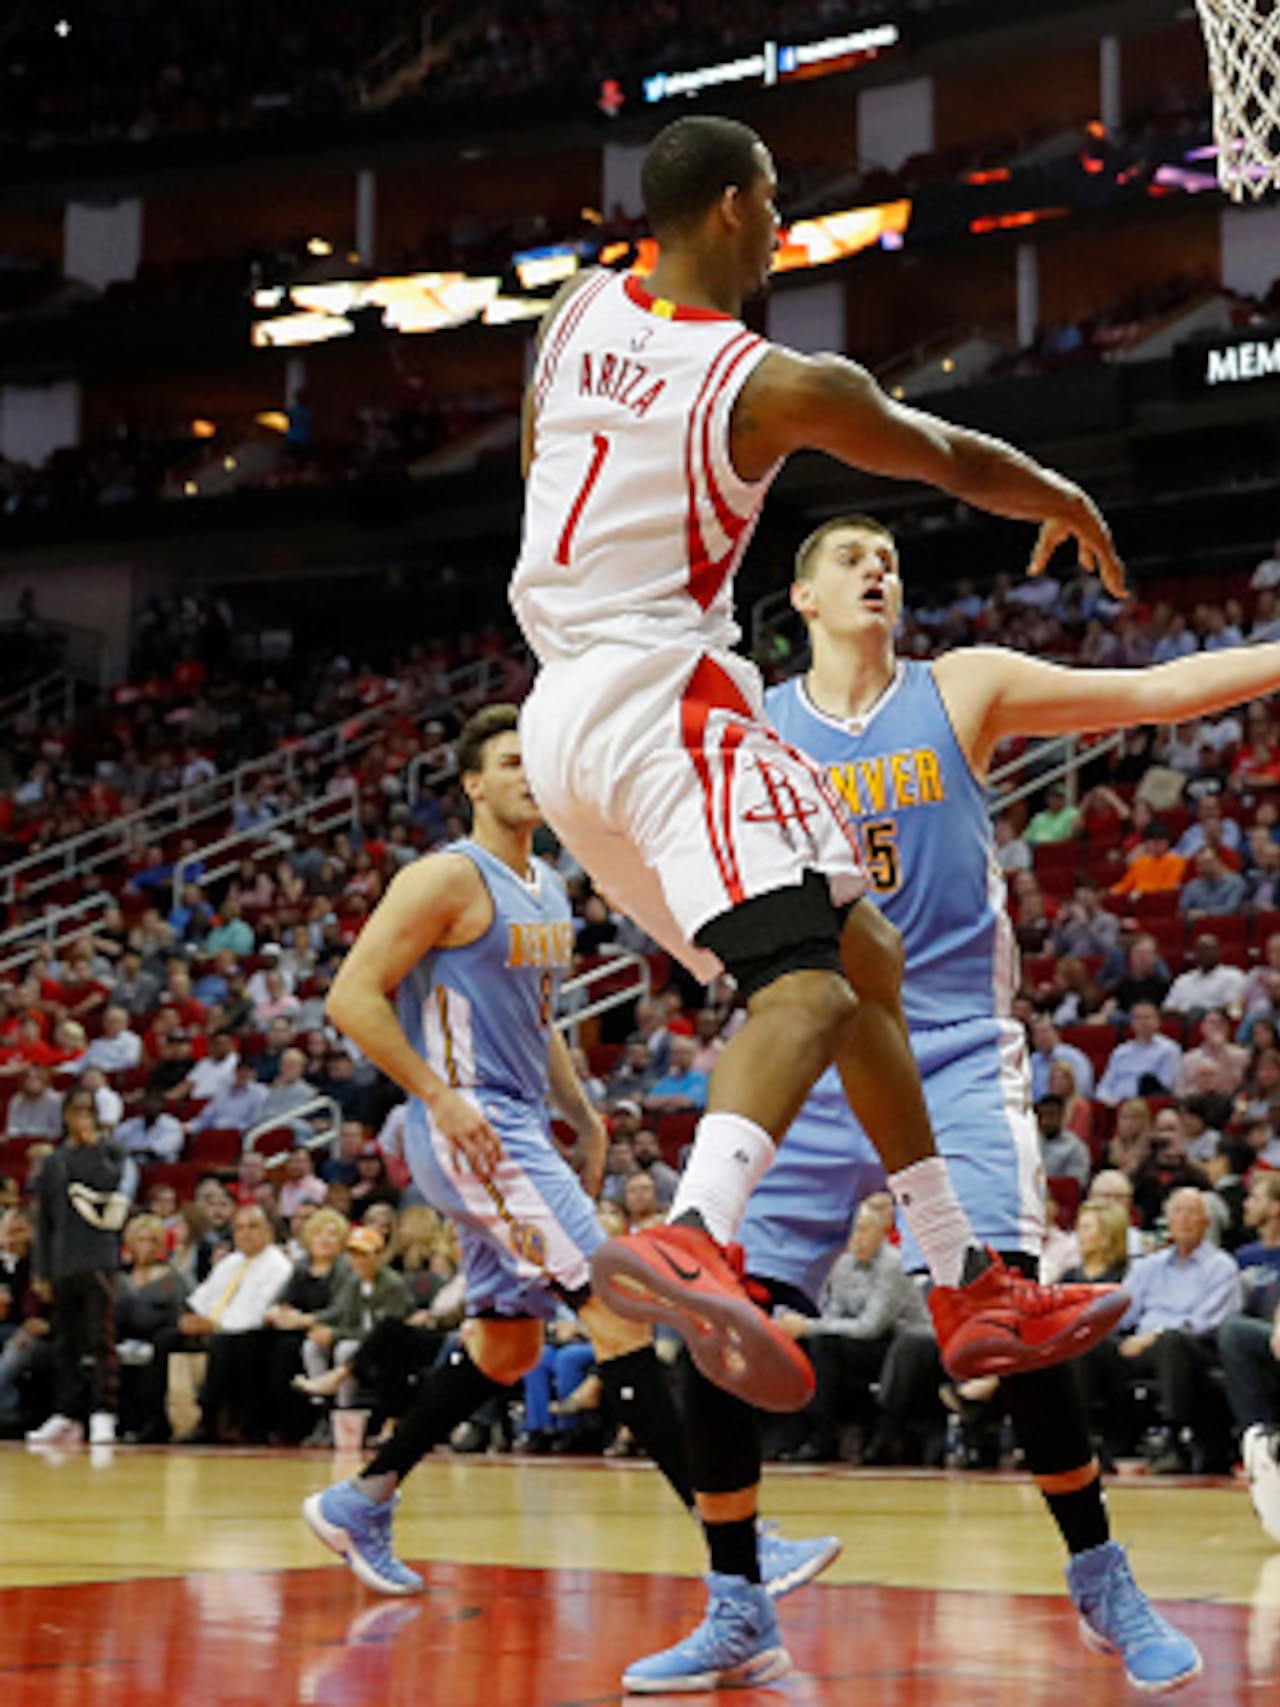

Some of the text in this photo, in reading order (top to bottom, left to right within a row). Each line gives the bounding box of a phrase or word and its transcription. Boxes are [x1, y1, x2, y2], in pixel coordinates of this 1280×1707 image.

[578, 352, 667, 418] ARIZA
[554, 431, 610, 567] 1
[826, 747, 947, 816] NVER
